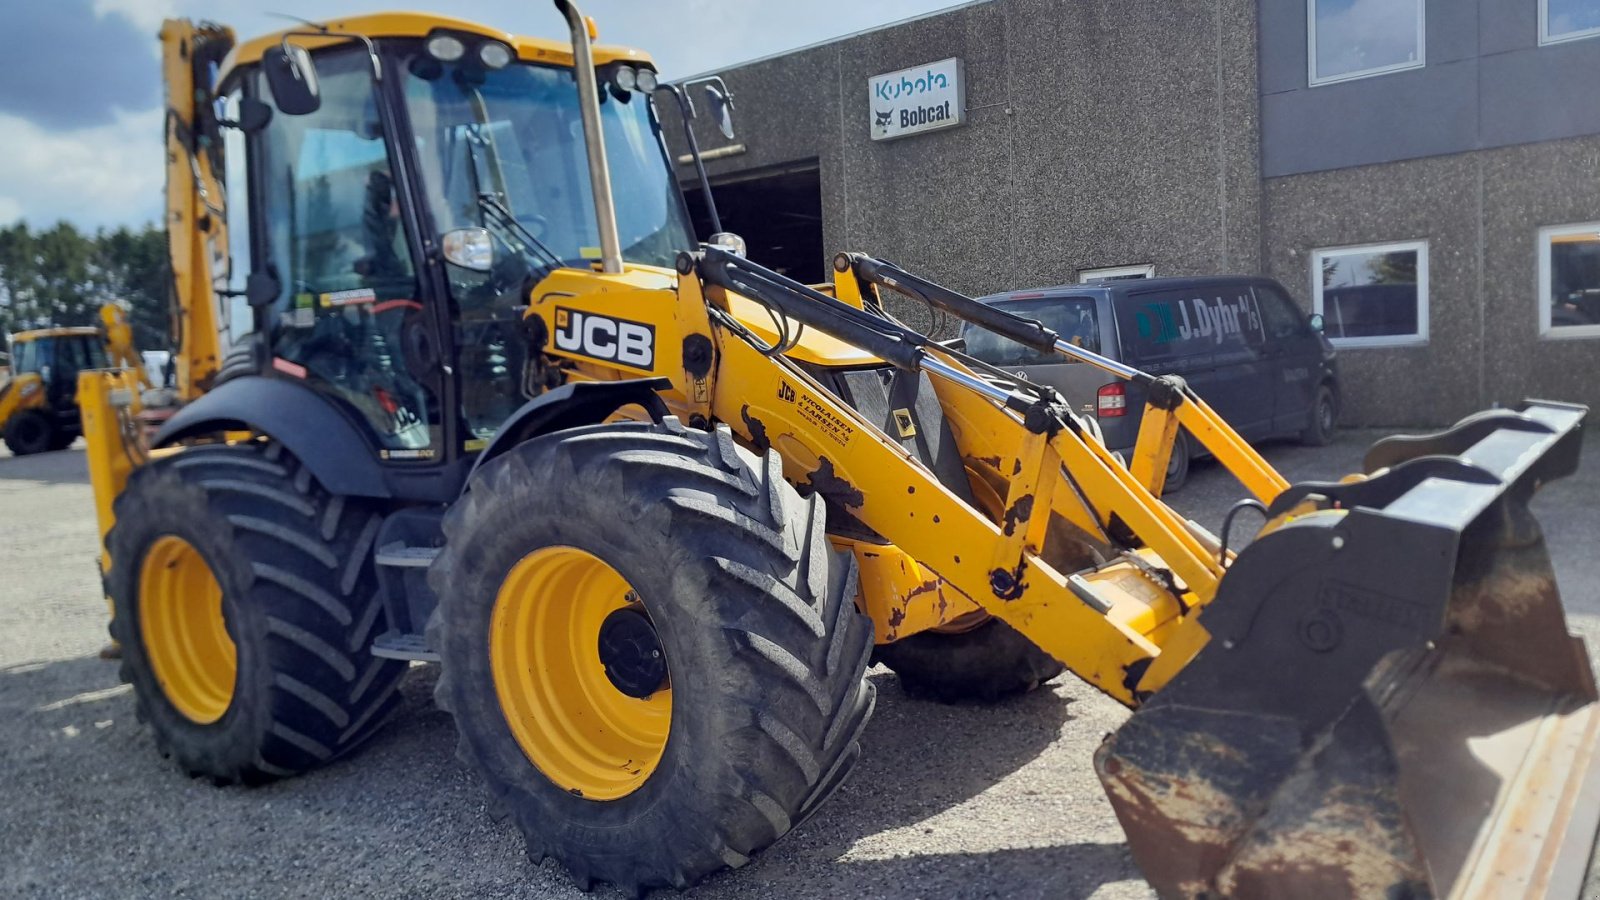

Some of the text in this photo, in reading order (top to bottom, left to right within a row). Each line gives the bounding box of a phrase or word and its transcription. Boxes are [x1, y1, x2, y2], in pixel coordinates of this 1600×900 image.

[876, 70, 947, 100] Kubota
[900, 100, 950, 128] Bobcat
[1178, 296, 1241, 344] J.Dyhr
[556, 312, 652, 366] JCB
[778, 380, 796, 402] JCB
[801, 394, 853, 433] NICOLAISEN
[804, 406, 840, 433] LARSEN
